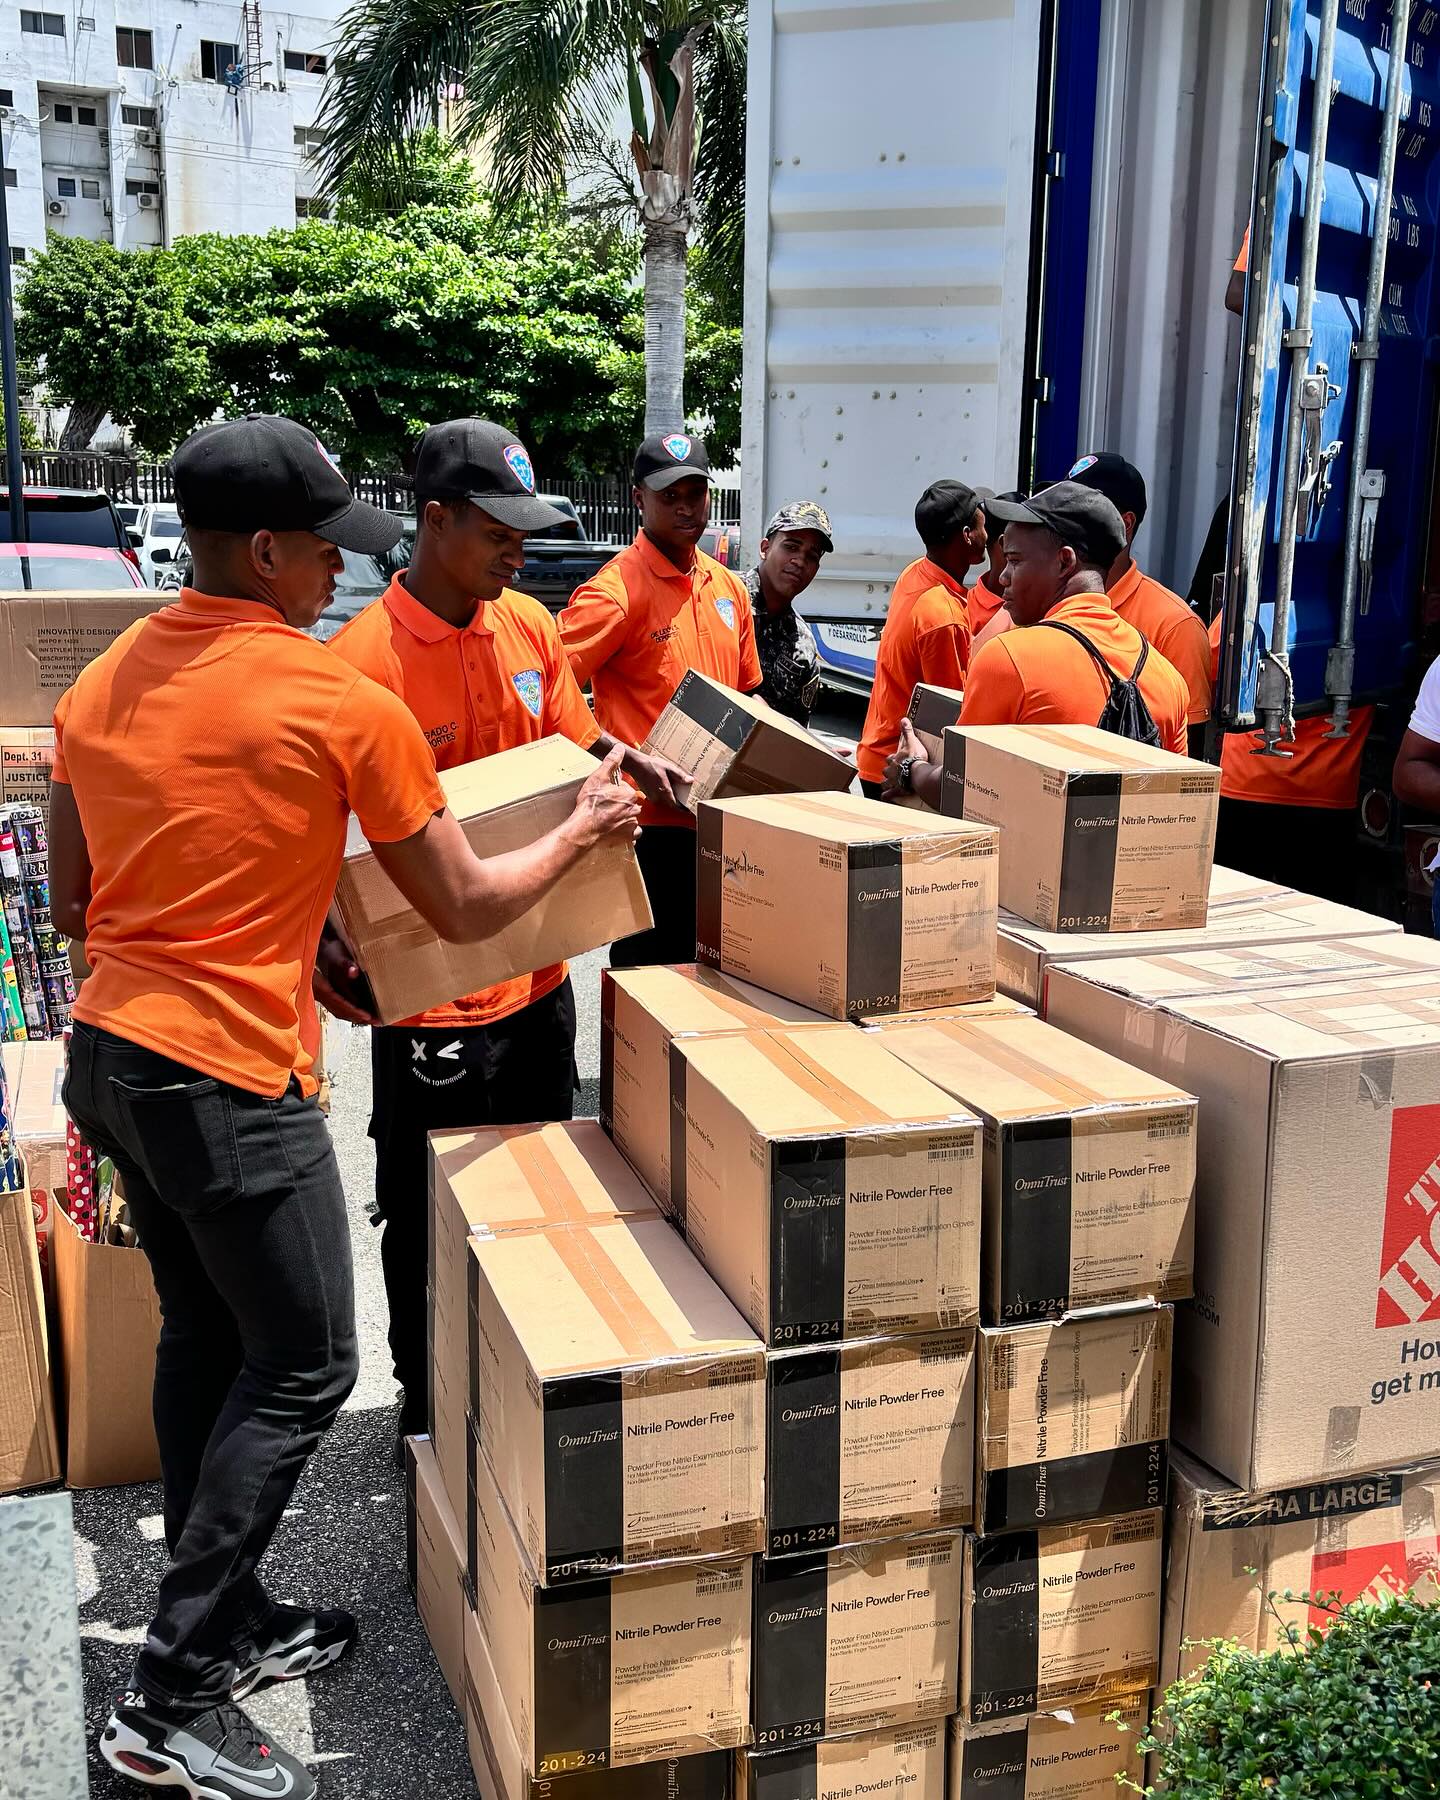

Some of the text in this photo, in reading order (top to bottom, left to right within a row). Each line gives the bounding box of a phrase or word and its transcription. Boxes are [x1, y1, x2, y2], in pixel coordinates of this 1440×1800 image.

[1419, 101, 1431, 127] KGS
[1407, 223, 1420, 248] LBS
[833, 629, 866, 643] DESARROLLO
[4, 752, 42, 763] Dept. 31
[5, 773, 48, 781] JUSTICE
[966, 778, 999, 800] Nitrile Powder Free
[1074, 816, 1116, 828] OmniTrust
[1122, 814, 1196, 825] Nitrile Powder Free
[754, 864, 765, 876] Free
[858, 888, 901, 902] OmniTrust
[905, 879, 979, 896] Nitrile Powder Free
[1060, 915, 1108, 928] 201-224
[697, 942, 720, 960] 201-224
[850, 994, 897, 1012] 201-224
[412, 1067, 467, 1086] BETTER TOMORROW
[1015, 1175, 1067, 1191] OmniTrust
[1075, 1163, 1171, 1184] Nitrile Powder Free
[783, 1194, 841, 1210] OmniTrust
[849, 1185, 953, 1204] Nitrile Powder Free
[1074, 1209, 1099, 1218] Powder
[849, 1229, 874, 1238] Powder
[876, 1228, 891, 1237] Free
[952, 1220, 975, 1229] Gloves
[1005, 1297, 1065, 1317] 201-224
[774, 1322, 840, 1340] 201-224
[734, 1358, 756, 1367] NUMBER
[1371, 1373, 1412, 1405] get
[844, 1388, 945, 1411] Nitrile Powder Free
[1037, 1358, 1048, 1458] Nitrile Powder Free
[781, 1404, 837, 1422] OmniTrust
[627, 1411, 735, 1438] Nitrile Powder Free
[558, 1430, 618, 1448] OmniTrust
[844, 1436, 869, 1445] Powder
[870, 1432, 885, 1442] Free
[886, 1430, 904, 1439] Nitrile
[627, 1464, 654, 1472] Powder
[655, 1460, 672, 1468] Free
[693, 1449, 733, 1462] Examination
[1148, 1444, 1159, 1504] 201-224
[1035, 1465, 1048, 1518] OmniTrust
[1309, 1480, 1392, 1513] LARGE
[773, 1526, 836, 1549] 201-224
[551, 1554, 618, 1577] 201-224
[1042, 1561, 1136, 1588] Nitrile Powder Free
[982, 1582, 1036, 1599] OmniTrust
[831, 1588, 930, 1614] Nitrile Powder Free
[767, 1607, 823, 1625] OmniTrust
[1042, 1609, 1066, 1620] Powder
[1067, 1607, 1082, 1616] Free
[1083, 1604, 1098, 1613] Nitrile
[615, 1616, 722, 1641] Nitrile Powder Free
[830, 1636, 854, 1645] Powder
[856, 1633, 871, 1642] Free
[929, 1619, 951, 1628] Gloves
[547, 1634, 607, 1651] OmniTrust
[615, 1666, 641, 1674] Powder
[680, 1653, 720, 1664] Examination
[721, 1647, 744, 1656] Gloves
[124, 1691, 146, 1708] 24
[974, 1693, 1034, 1715] 201-224
[759, 1720, 822, 1743] 201-224
[539, 1751, 606, 1773] 201-224
[1030, 1743, 1120, 1768] Nitrile Powder Free
[973, 1761, 1023, 1779] OmniTrust
[821, 1773, 917, 1800] Nitrile Powder Free
